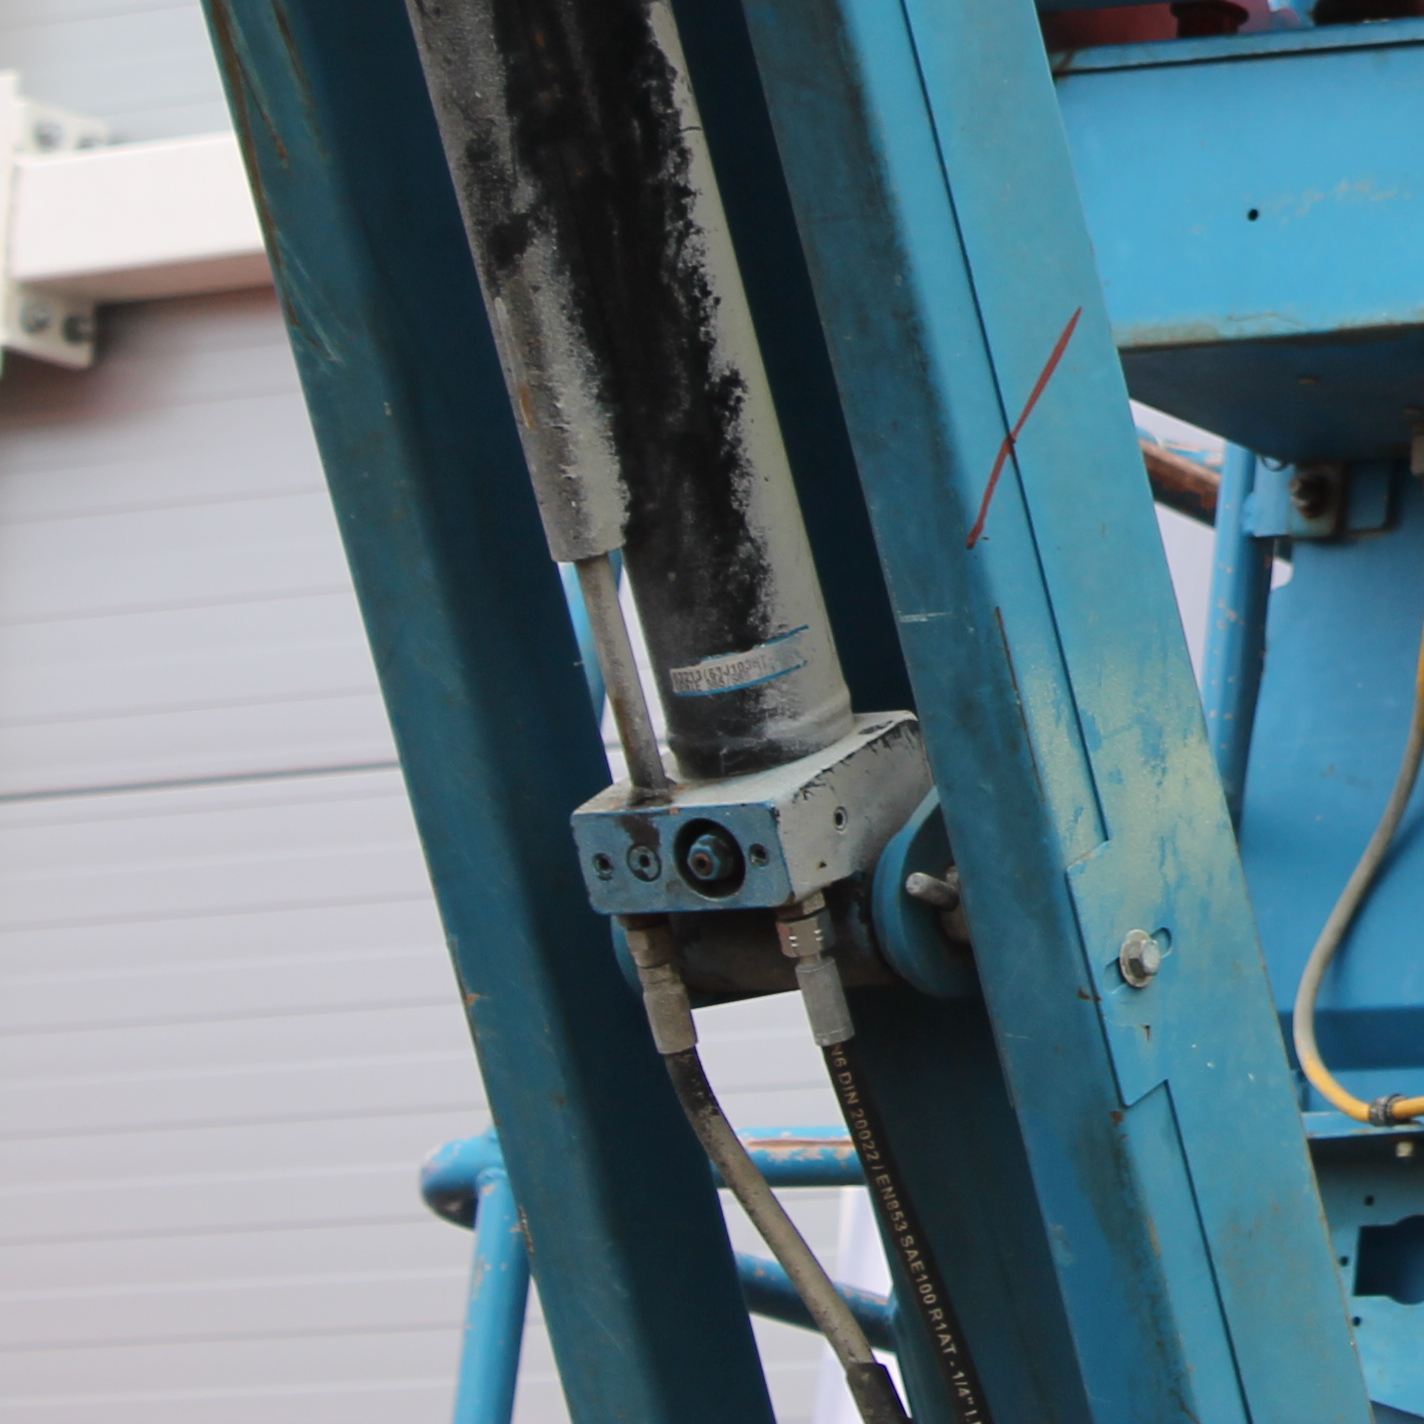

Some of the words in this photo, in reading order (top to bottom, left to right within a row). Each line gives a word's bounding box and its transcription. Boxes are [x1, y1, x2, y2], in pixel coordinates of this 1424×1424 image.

[839, 1072, 859, 1104] DIN
[850, 1109, 880, 1161] 20022
[875, 1174, 908, 1231] EN853
[900, 1235, 937, 1304] SAE100
[929, 1308, 957, 1353] R1AT
